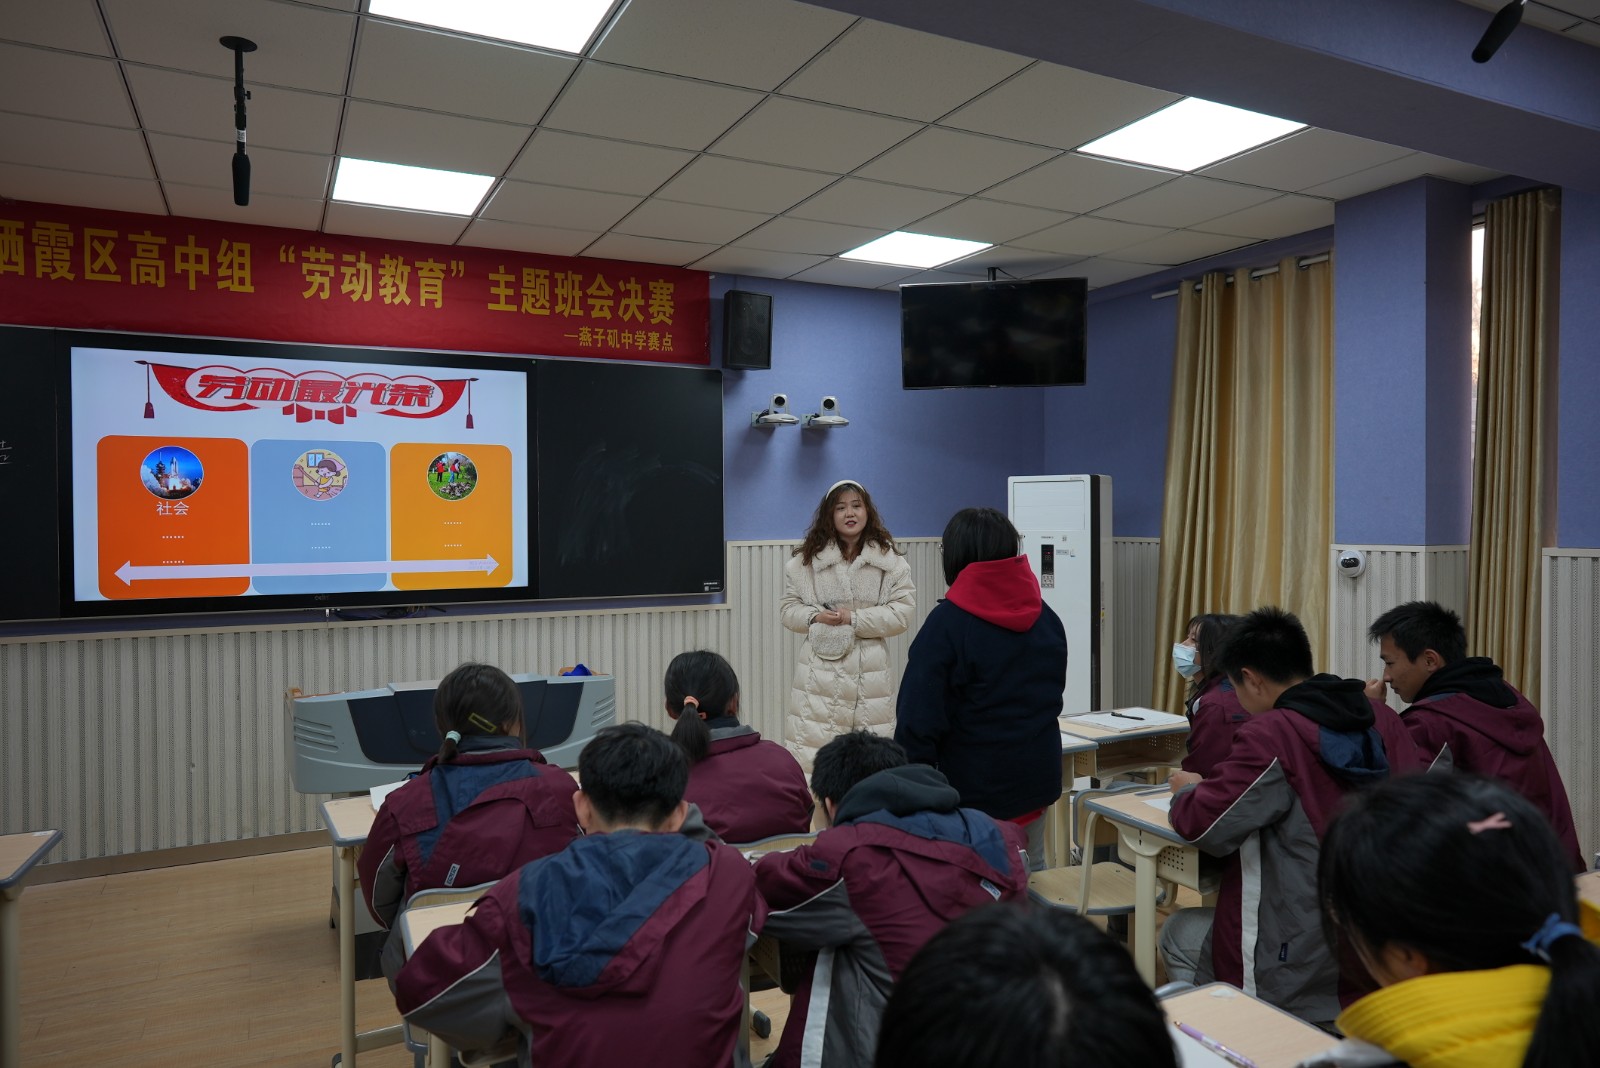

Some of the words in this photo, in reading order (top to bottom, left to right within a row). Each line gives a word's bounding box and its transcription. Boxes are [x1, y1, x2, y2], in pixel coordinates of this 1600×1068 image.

[487, 265, 675, 325] 主题班会决赛
[196, 374, 436, 408] 劳动最光荣
[156, 501, 189, 516] 社会
